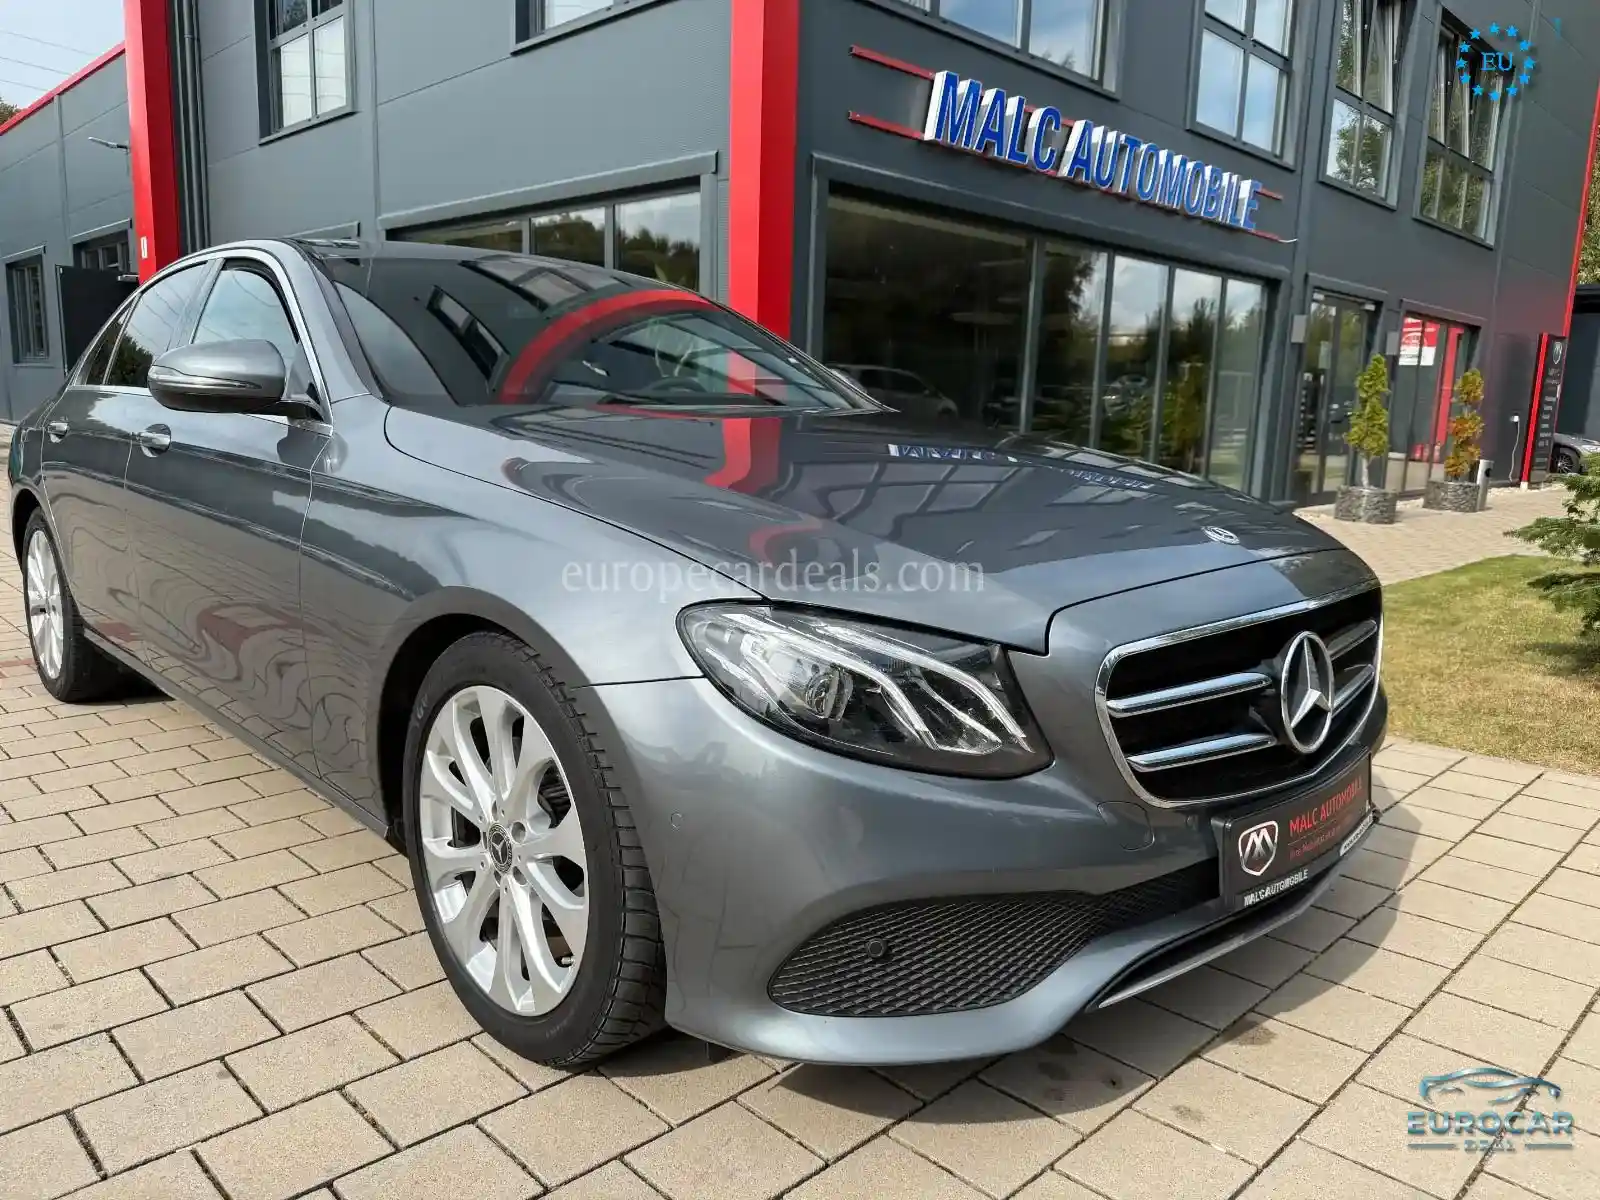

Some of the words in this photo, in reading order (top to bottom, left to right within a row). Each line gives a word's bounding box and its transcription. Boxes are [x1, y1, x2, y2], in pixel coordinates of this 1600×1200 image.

[925, 70, 1061, 172] MALC
[1057, 119, 1262, 230] AUTOMOBILE
[1289, 807, 1318, 838] MALC
